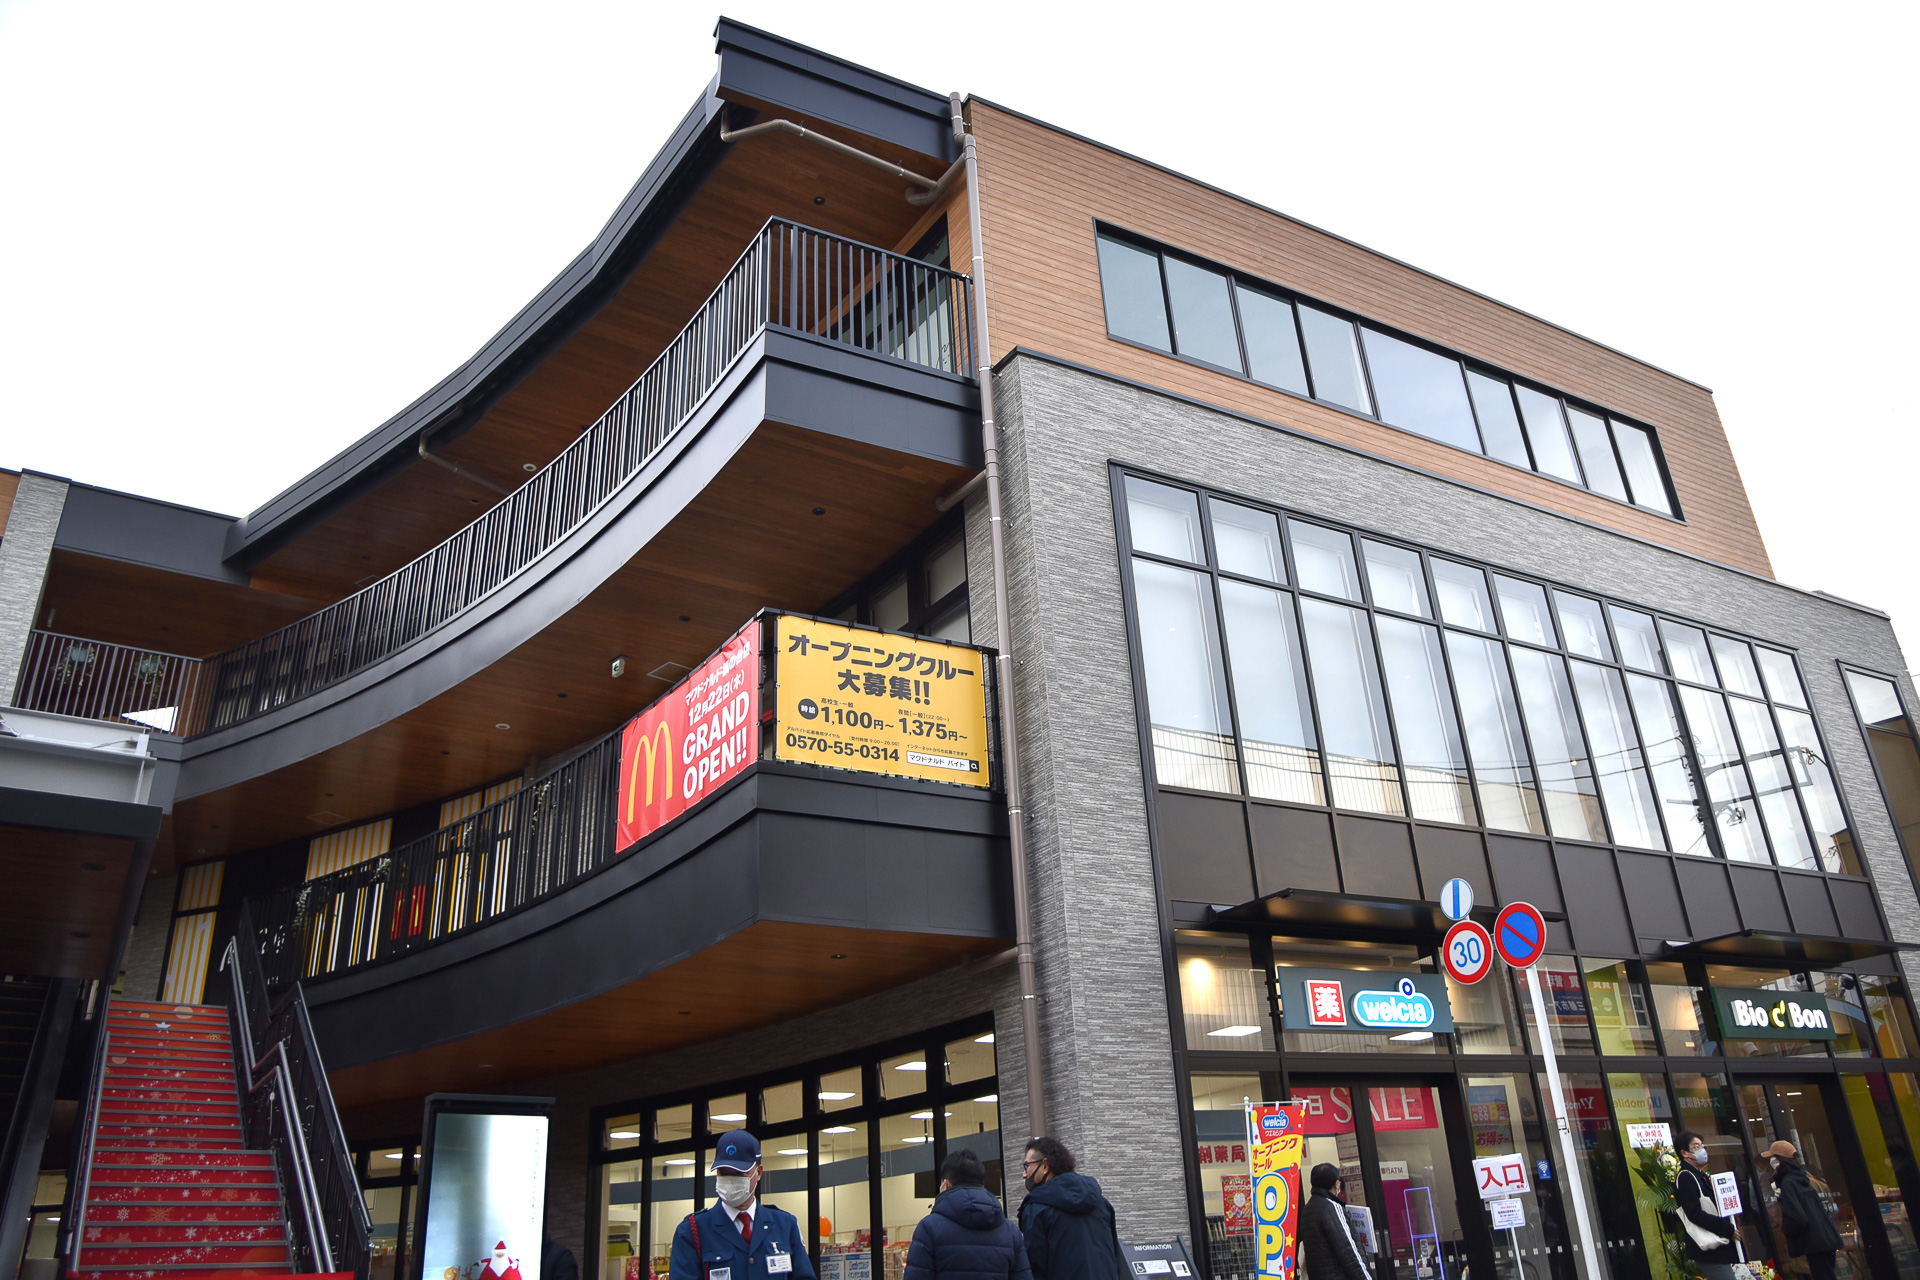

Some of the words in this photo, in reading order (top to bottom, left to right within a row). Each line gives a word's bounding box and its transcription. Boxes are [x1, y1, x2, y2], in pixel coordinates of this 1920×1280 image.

[788, 634, 975, 680] オープニングクルー
[837, 668, 931, 706] 大募集!!
[682, 690, 750, 765] GRAND
[682, 725, 748, 800] OPEN!!
[785, 733, 900, 762] 0570-55-0314
[1453, 937, 1481, 968] 30
[1313, 986, 1342, 1019] 薬
[1361, 982, 1427, 1022] welcia
[1732, 1000, 1769, 1027] Bio
[1788, 1002, 1828, 1029] Bon
[1263, 1113, 1287, 1127] welcia
[1252, 1136, 1299, 1158] オープニング
[1253, 1158, 1273, 1174] セール
[1480, 1163, 1525, 1191] 入口
[1257, 1175, 1287, 1280] OP
[1133, 1243, 1173, 1251] INFORMATION
